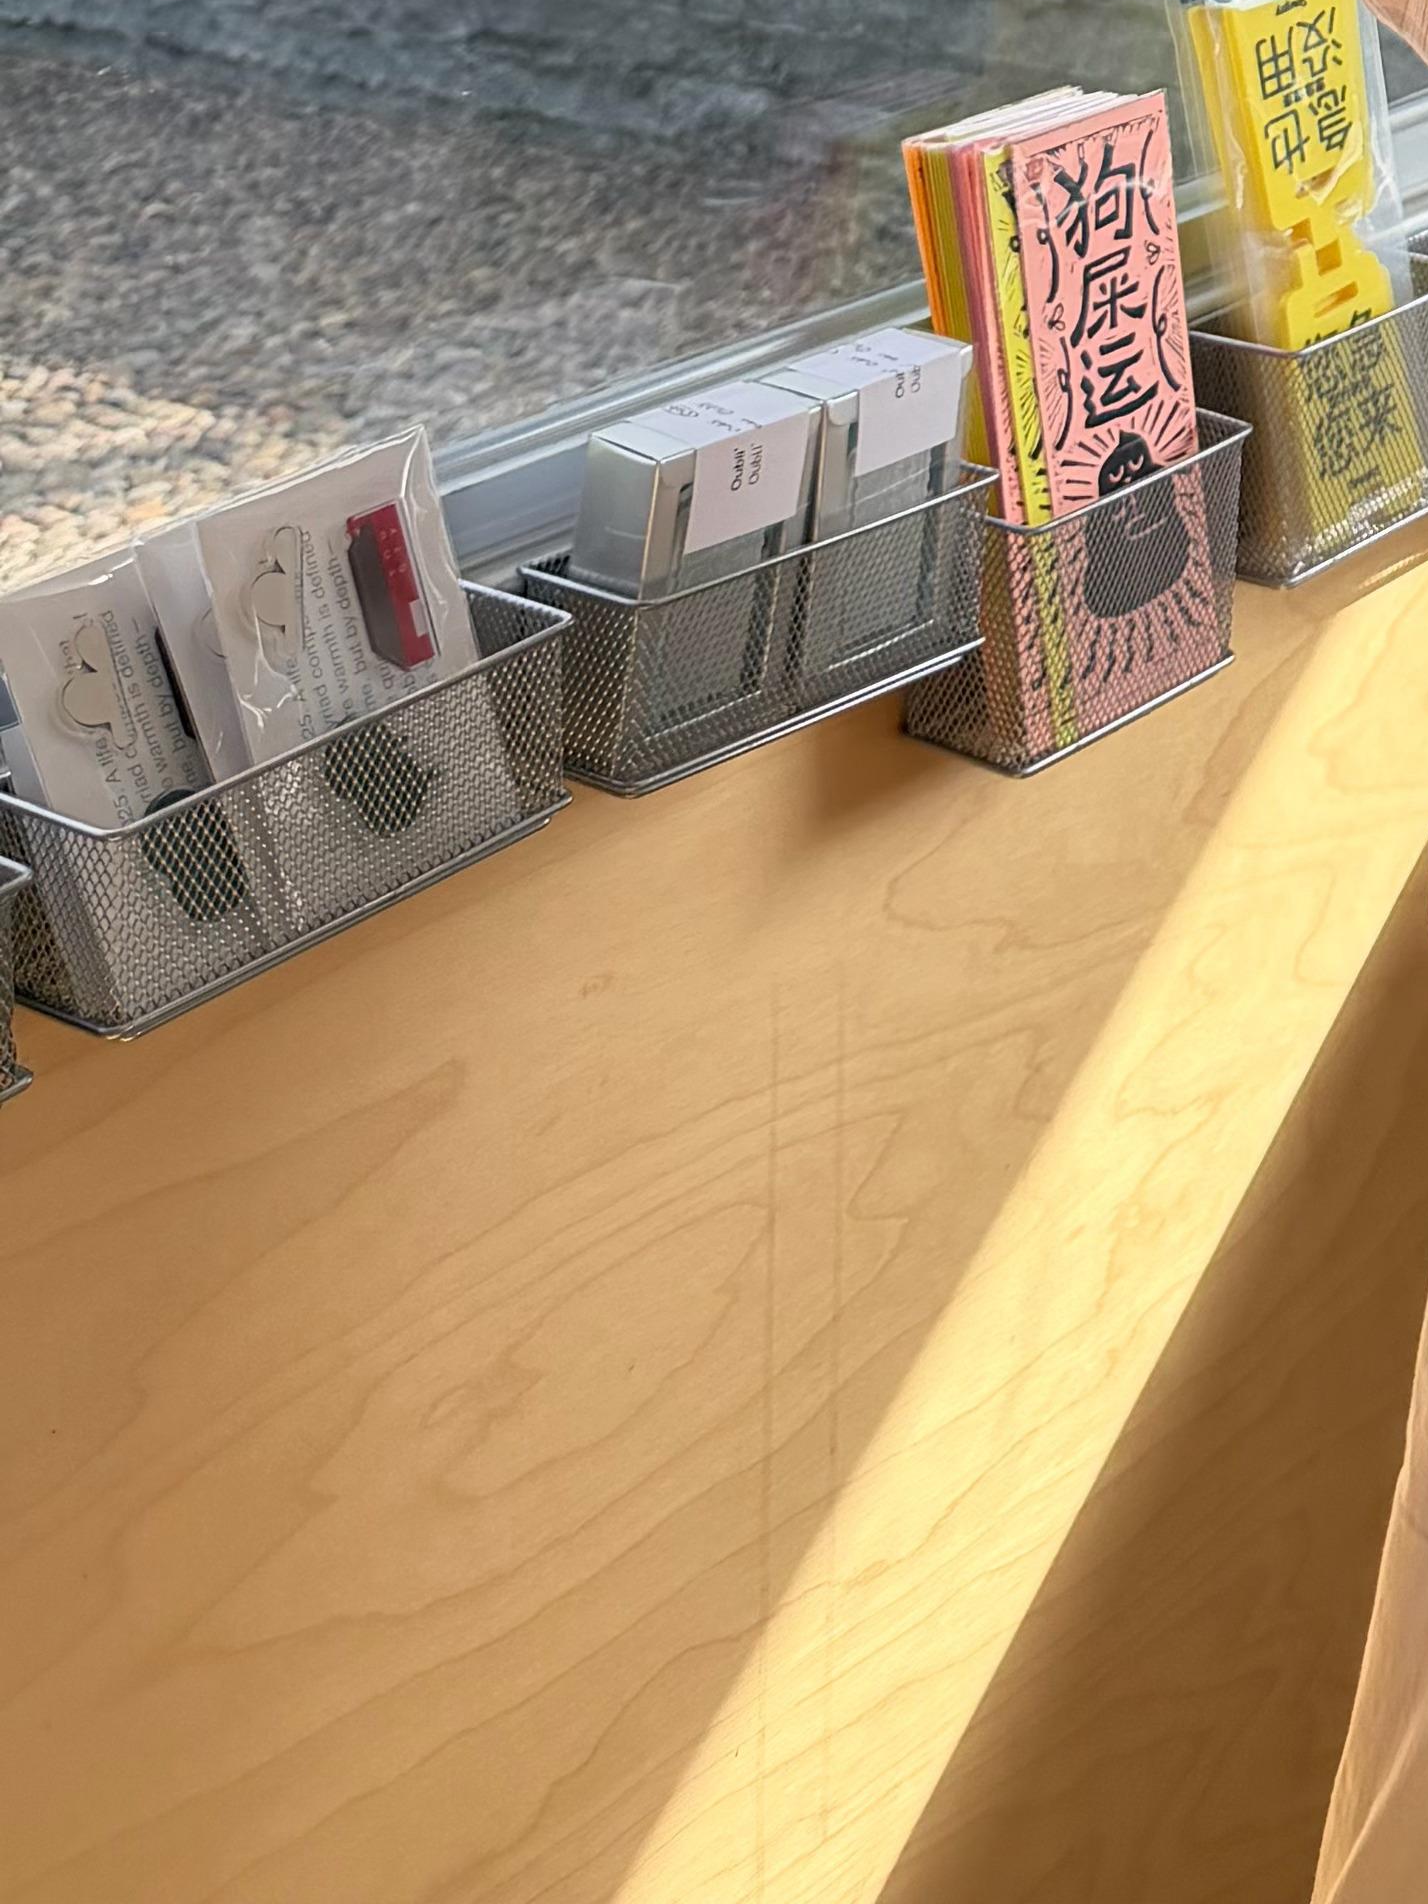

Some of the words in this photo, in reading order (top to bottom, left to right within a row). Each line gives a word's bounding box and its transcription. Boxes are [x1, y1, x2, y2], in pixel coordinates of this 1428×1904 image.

[1053, 142, 1159, 429] 狗屎运
[319, 603, 332, 622] is
[343, 616, 358, 640] by
[322, 623, 350, 695] warmth
[350, 641, 367, 675] but
[127, 682, 141, 701] is
[156, 694, 175, 718] by
[133, 702, 168, 774] warmth
[164, 720, 187, 754] but
[105, 768, 121, 783] A
